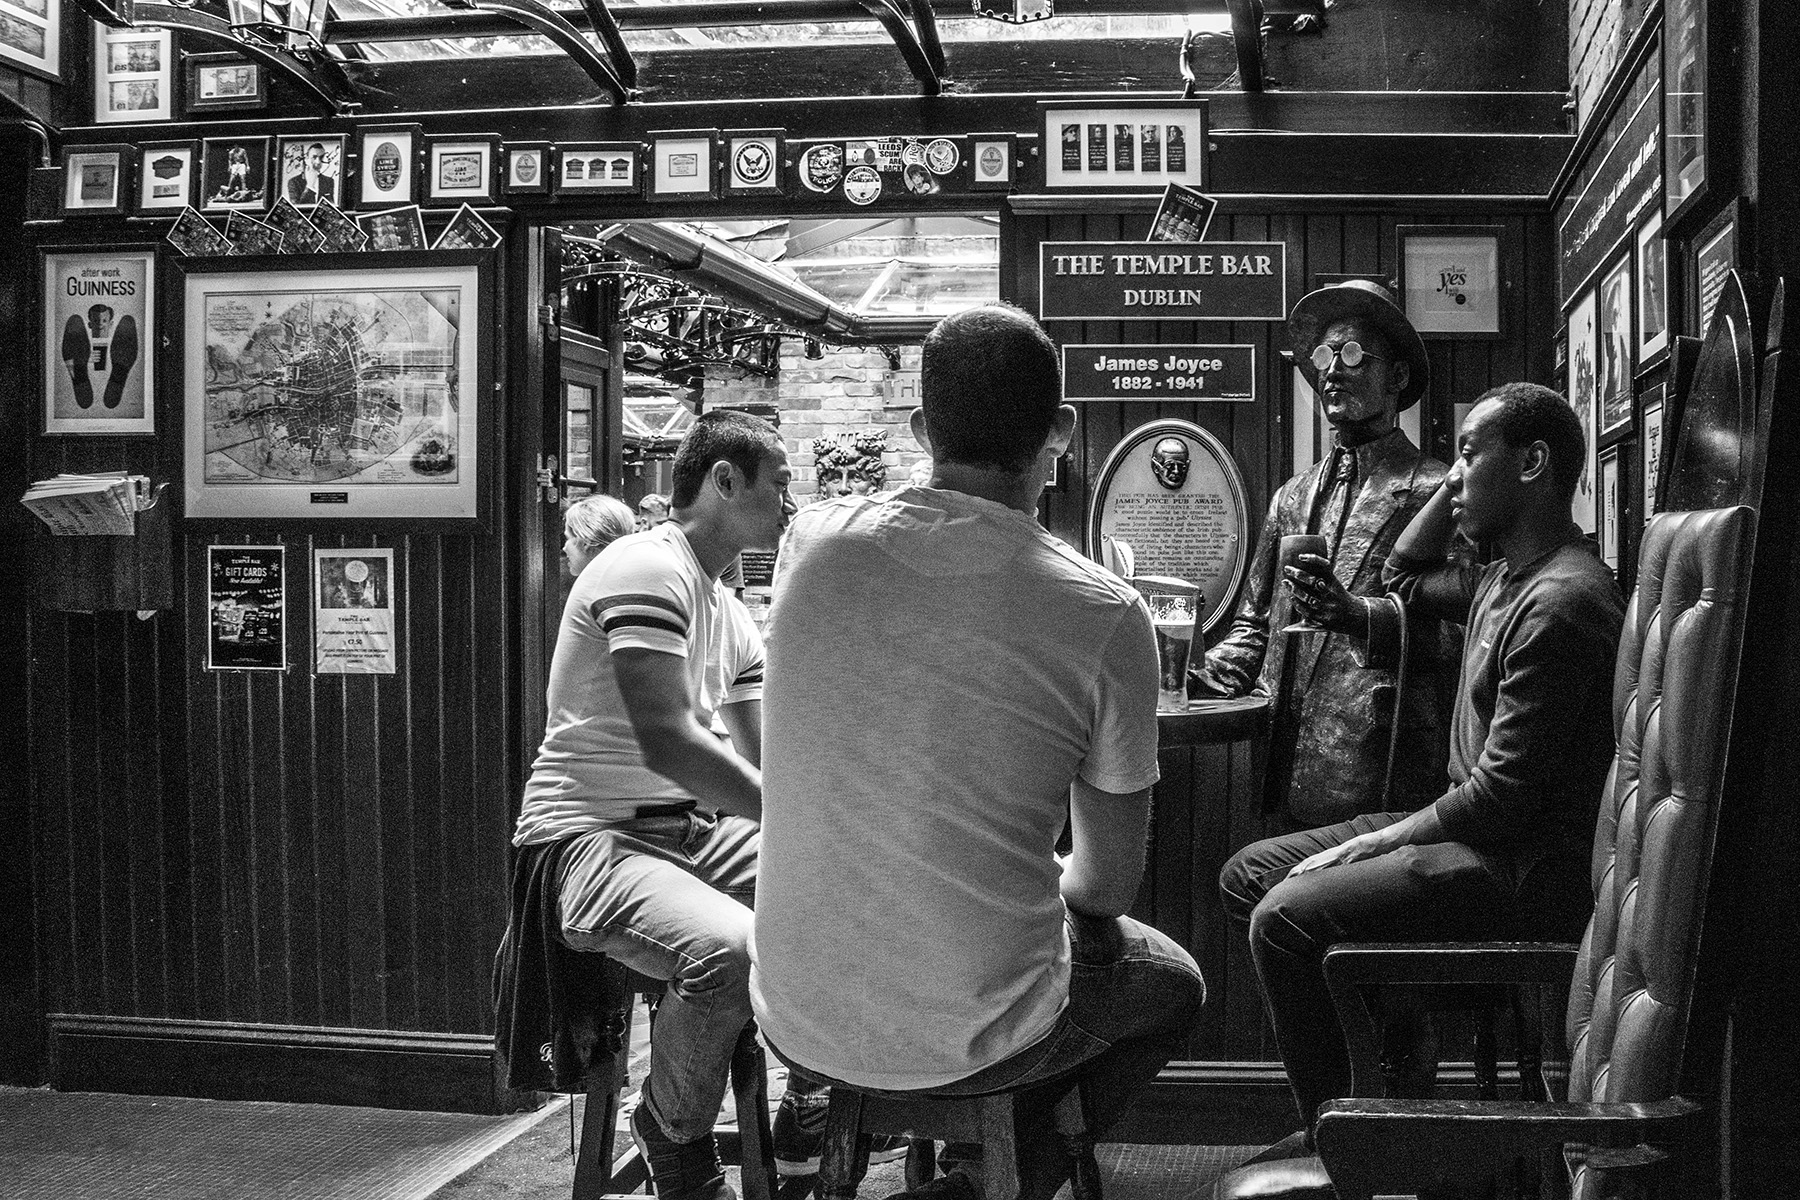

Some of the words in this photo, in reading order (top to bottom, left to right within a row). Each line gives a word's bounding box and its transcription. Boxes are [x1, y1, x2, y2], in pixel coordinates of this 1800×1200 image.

[878, 143, 902, 151] LEEDS
[812, 174, 838, 185] POLICE
[81, 267, 100, 278] after
[101, 267, 121, 278] work
[1052, 255, 1105, 276] THE
[1112, 255, 1214, 276] TEMPLE
[1221, 255, 1273, 276] BAR
[66, 276, 136, 297] GUINNESS
[1436, 272, 1467, 292] yes
[1124, 289, 1202, 306] DUBLIN
[1094, 355, 1159, 371] James
[1163, 355, 1223, 375] Joyce
[1112, 376, 1152, 390] 1882
[1166, 376, 1204, 390] 1941
[225, 567, 242, 577] GIFT
[243, 567, 268, 577] CARDS
